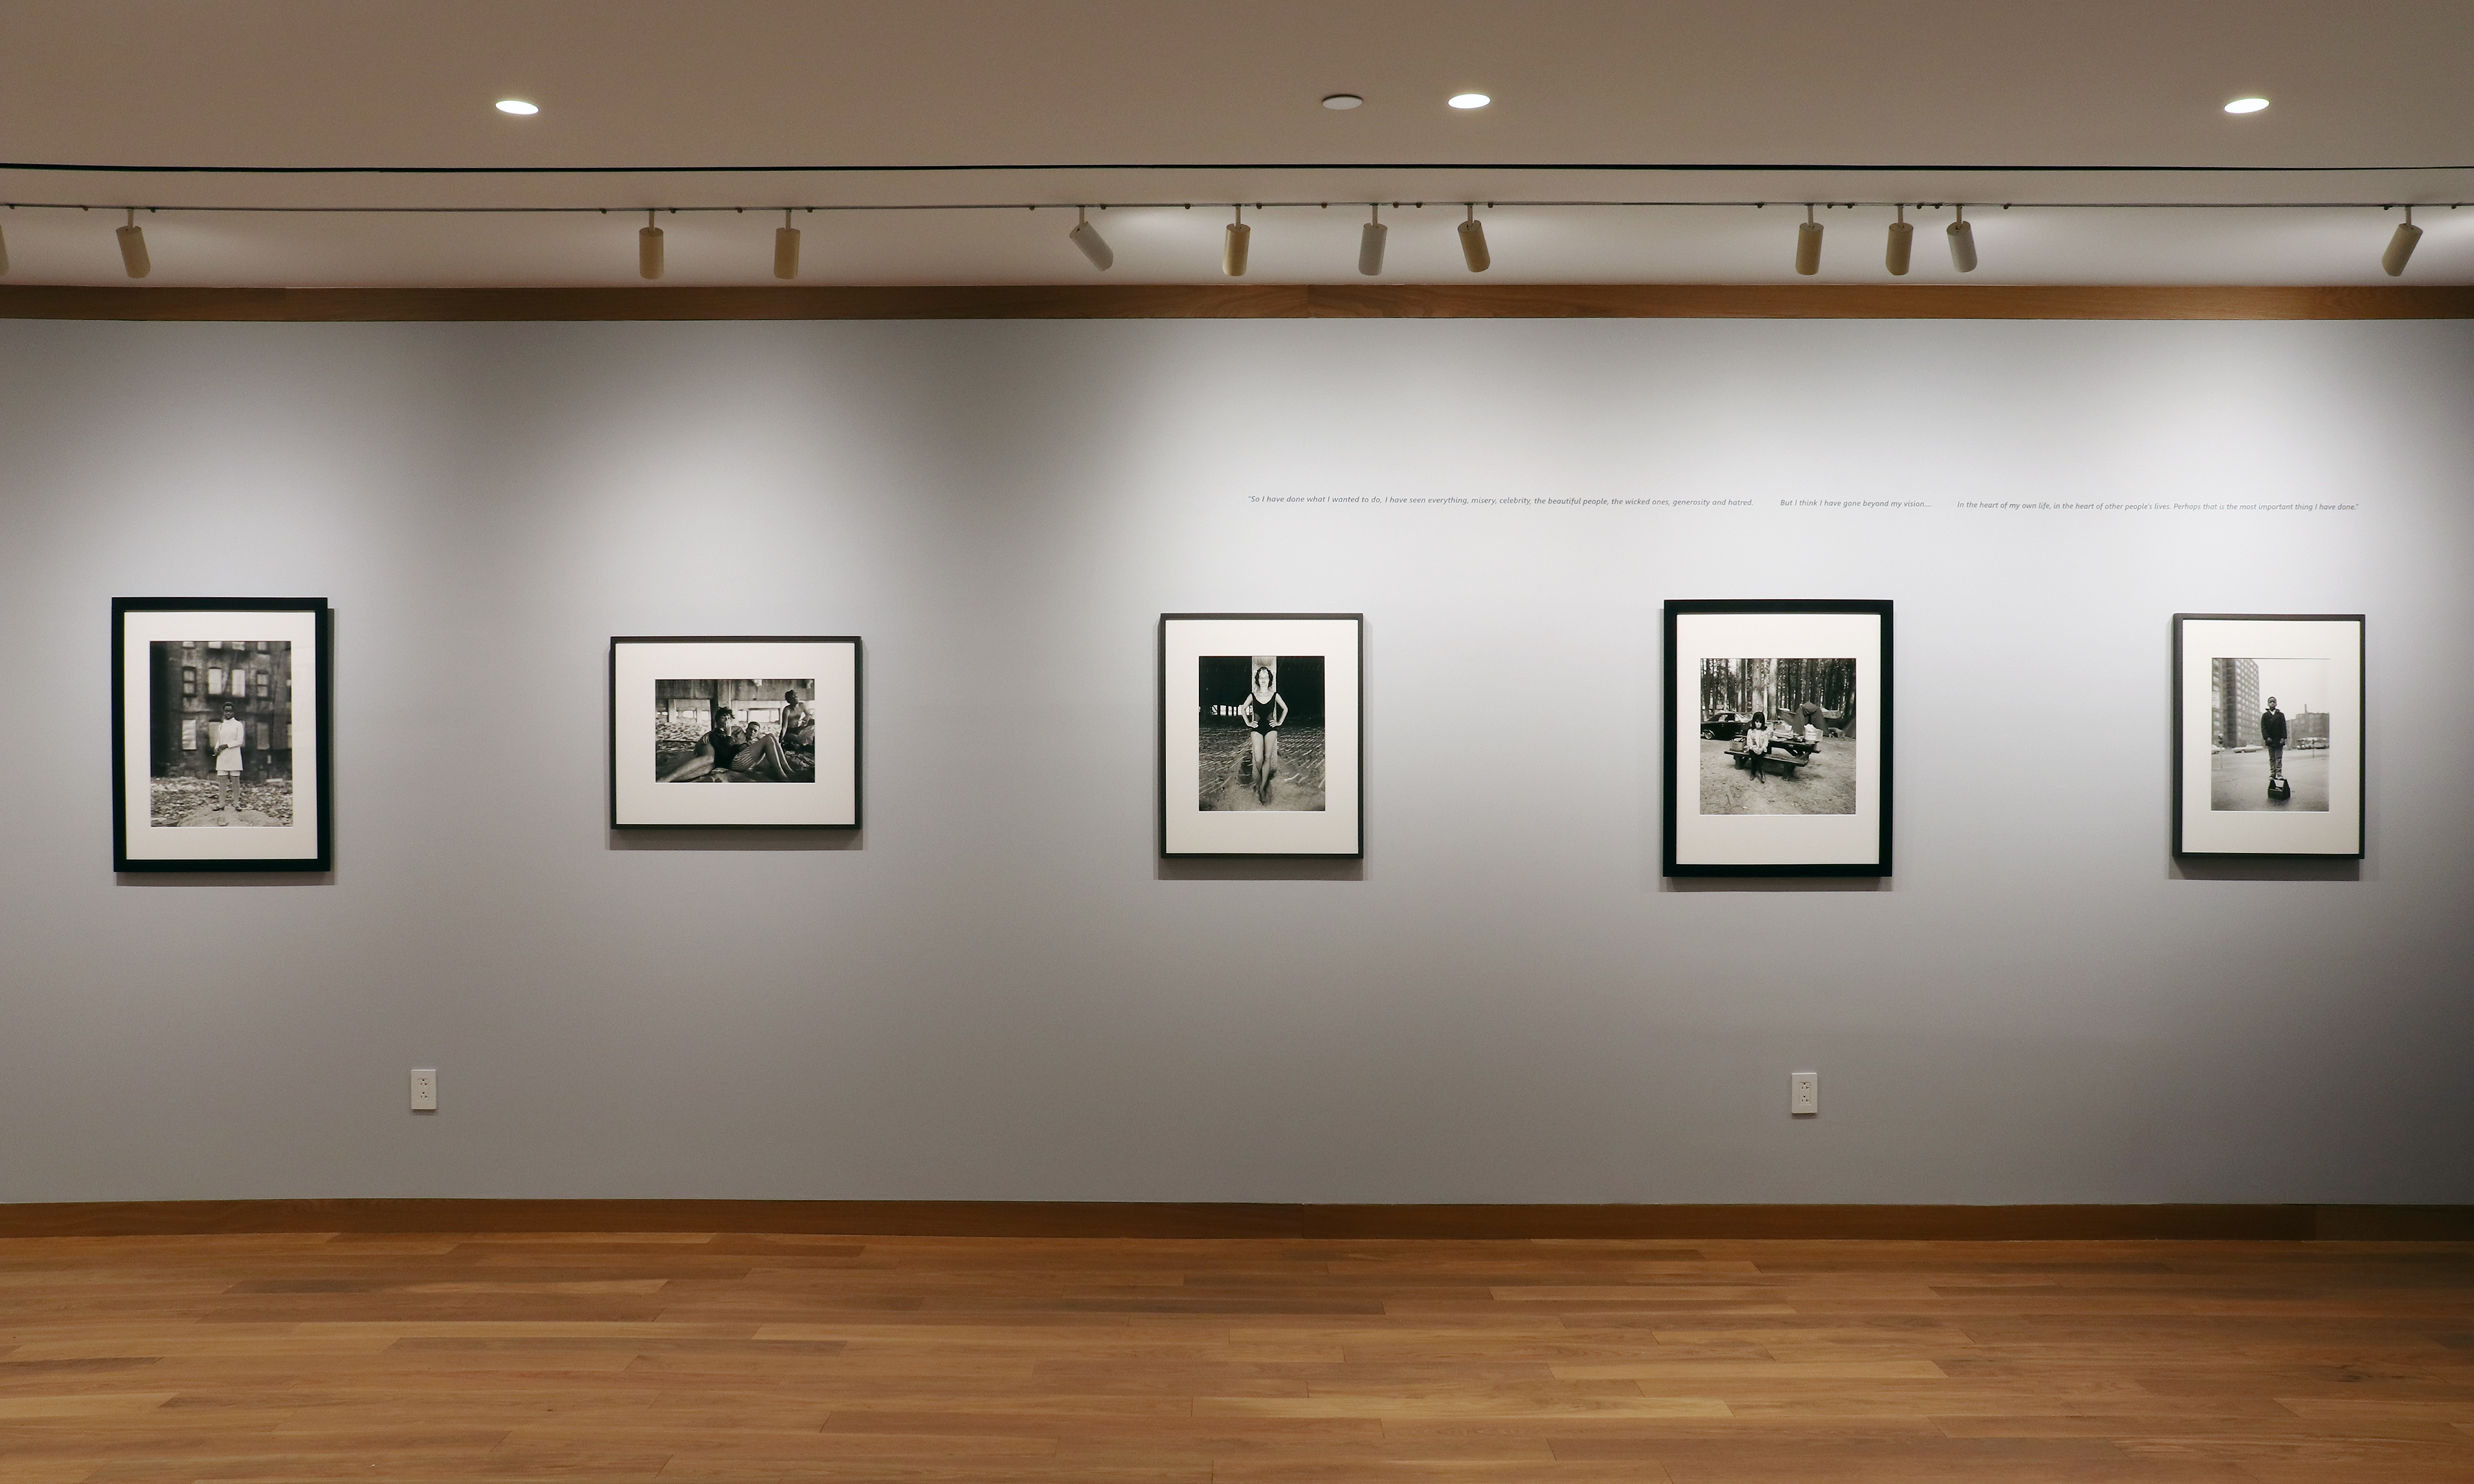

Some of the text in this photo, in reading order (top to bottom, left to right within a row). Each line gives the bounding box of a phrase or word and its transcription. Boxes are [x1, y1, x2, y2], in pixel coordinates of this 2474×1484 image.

[1428, 497, 1469, 505] everything,
[1471, 497, 1497, 505] misery,
[1500, 497, 1531, 505] celebrity,
[1548, 497, 1581, 506] beautiful
[1672, 499, 1710, 507] generosity
[2174, 503, 2200, 511] Perhaps
[2295, 504, 2313, 512] thing
